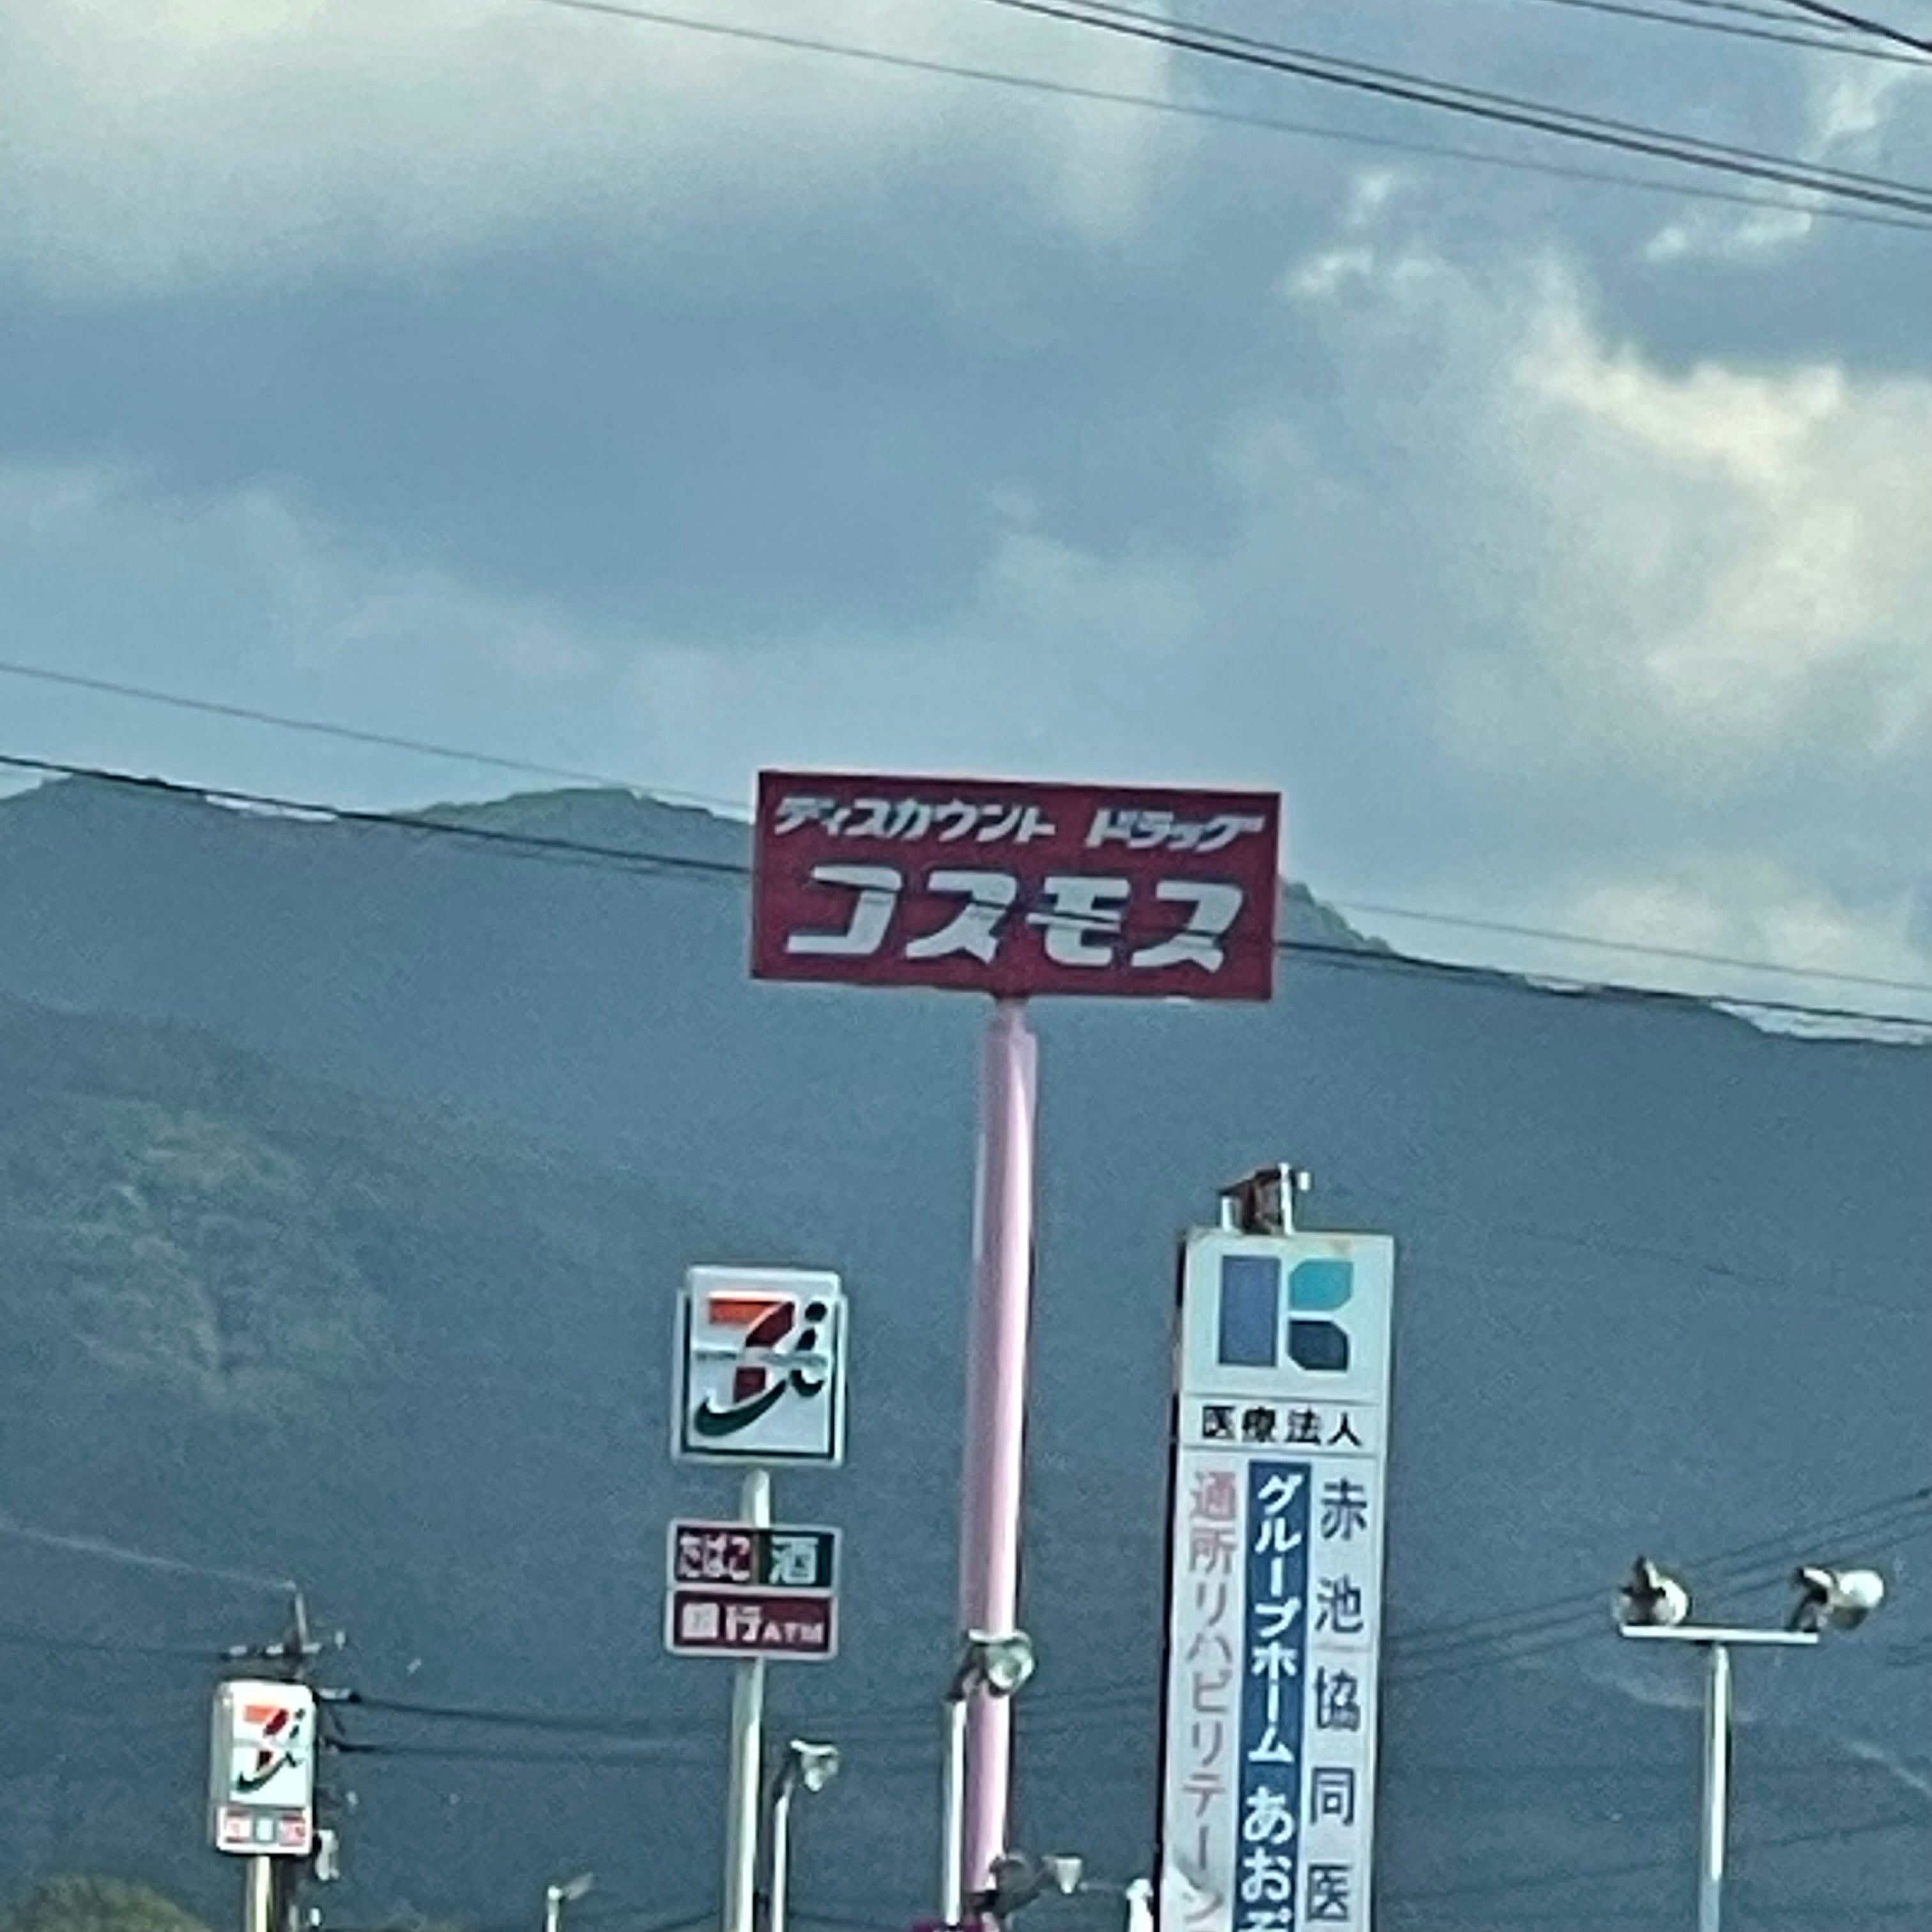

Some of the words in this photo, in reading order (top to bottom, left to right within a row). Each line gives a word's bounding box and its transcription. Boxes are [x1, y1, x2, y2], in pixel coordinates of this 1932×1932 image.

[774, 795, 1057, 843] ディスカウント
[1085, 807, 1266, 852] ドラッグ
[785, 864, 1243, 973] コスモス
[1201, 1405, 1363, 1447] 医療法人
[769, 1535, 819, 1584] 酒
[1247, 1473, 1303, 1763] グループホーム
[1182, 1471, 1238, 1932] 通所リハビリテーシ
[1307, 1476, 1367, 1922] 赤池協同医
